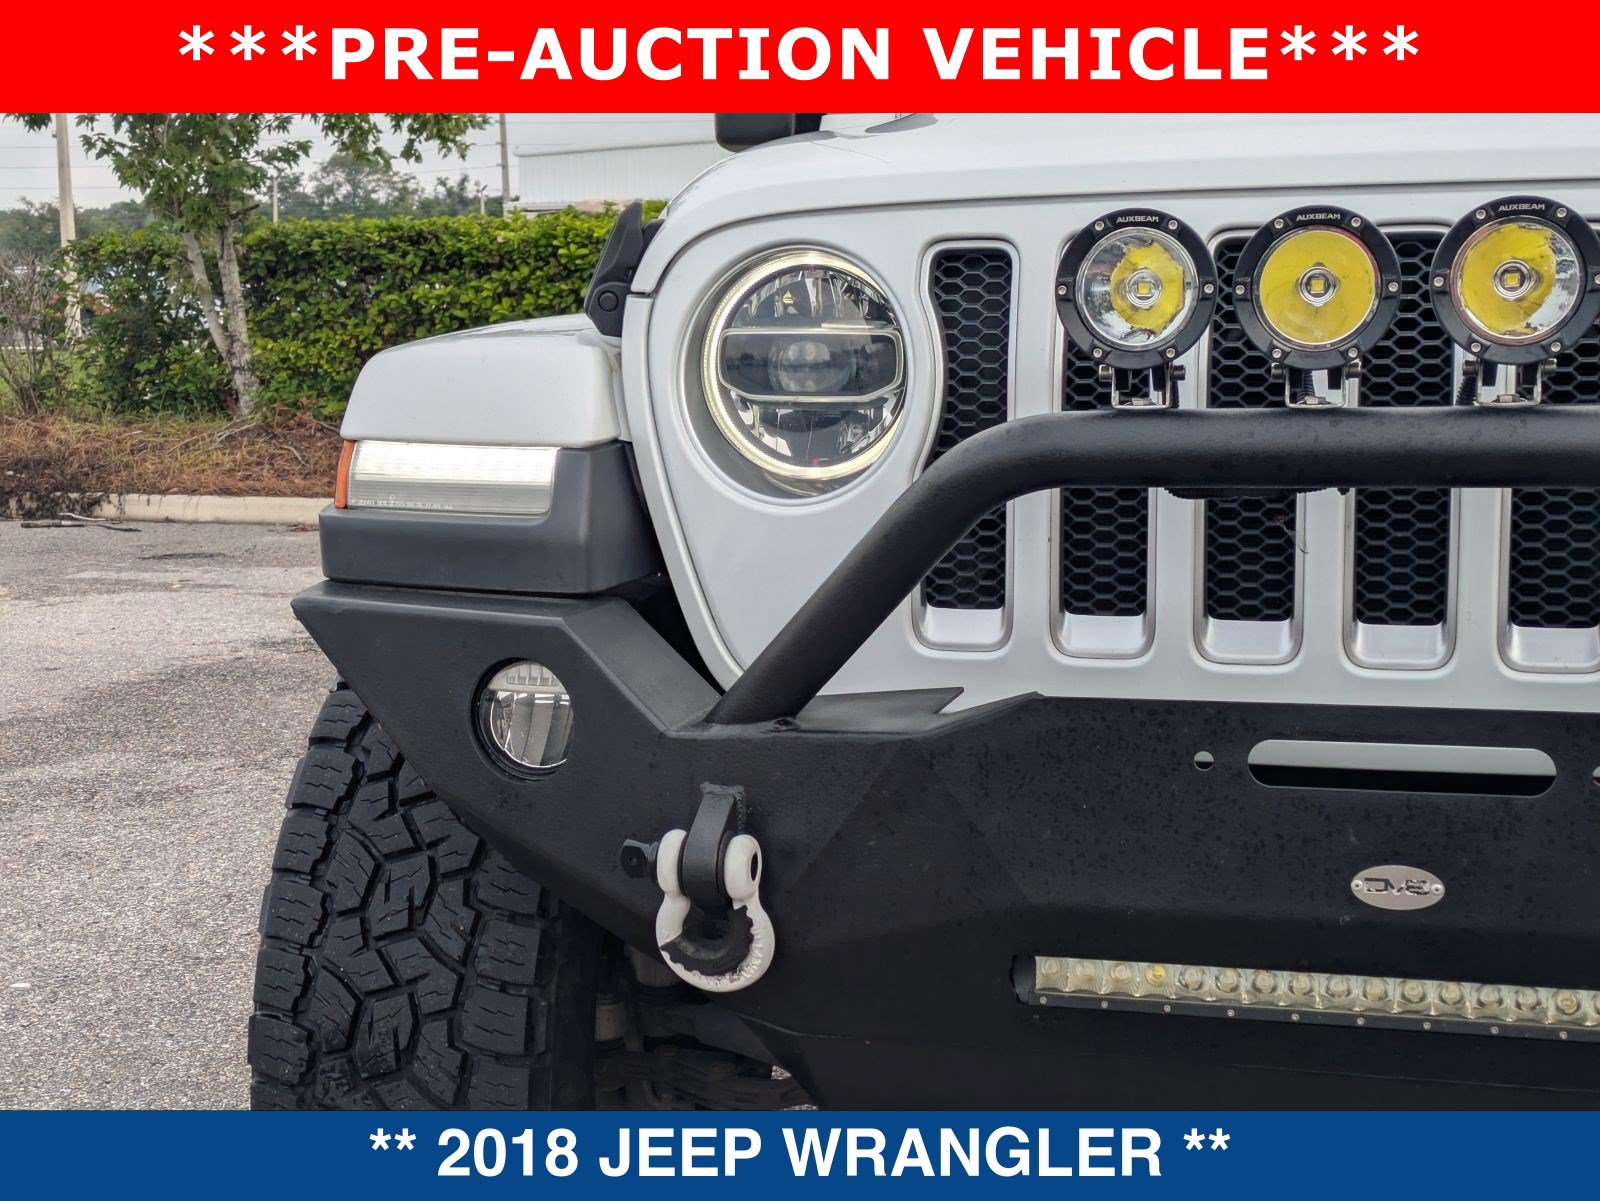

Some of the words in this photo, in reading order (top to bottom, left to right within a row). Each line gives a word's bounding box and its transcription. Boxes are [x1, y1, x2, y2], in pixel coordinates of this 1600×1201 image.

[1498, 203, 1545, 211] AUXBEAM
[1116, 215, 1159, 223] AUXBEAM
[1296, 213, 1341, 221] AUXBEAM
